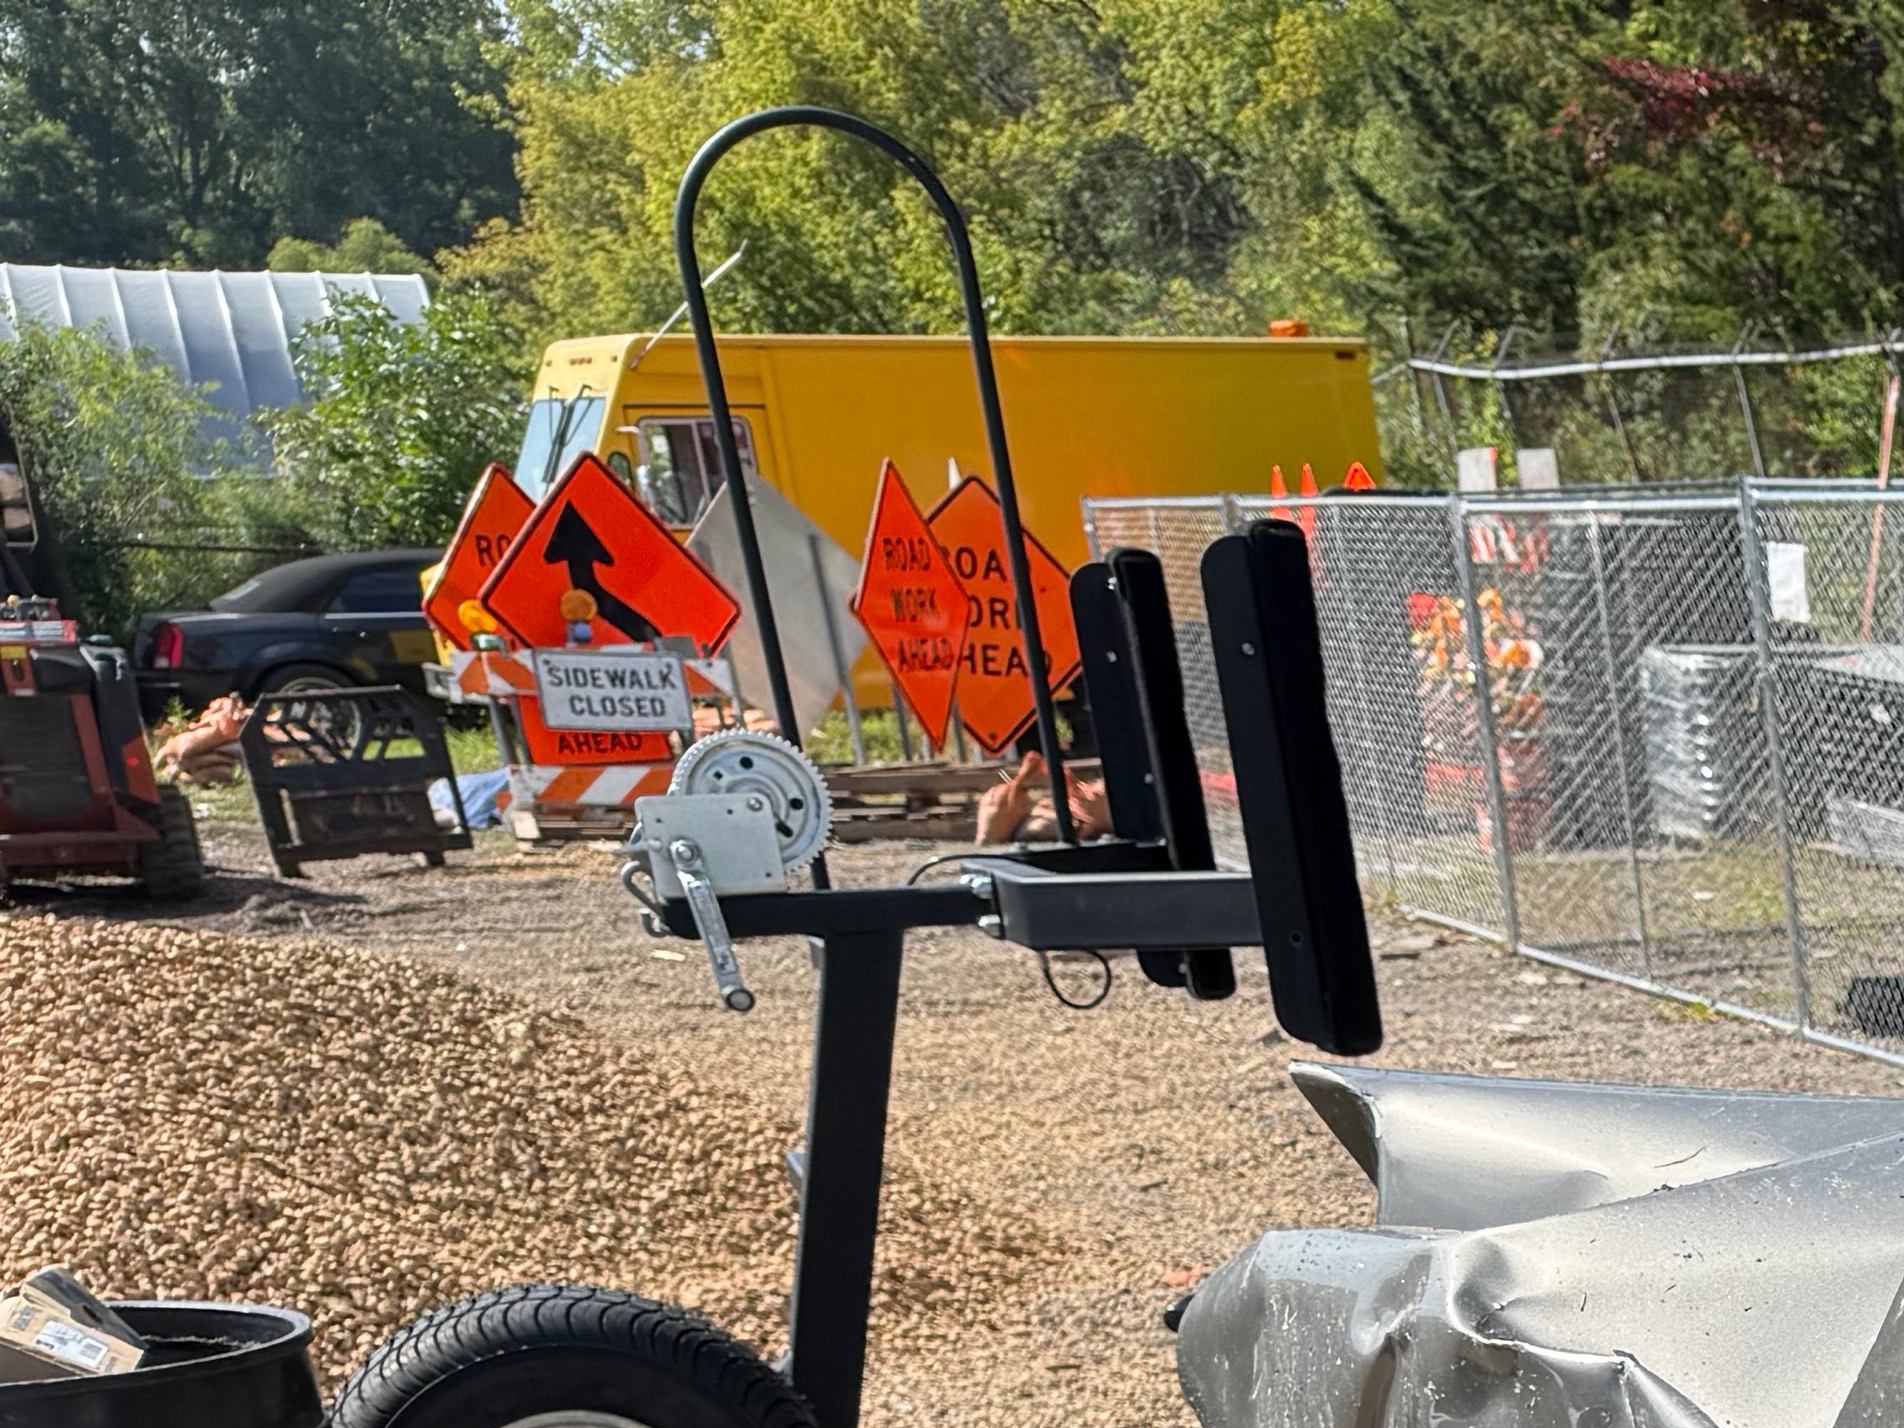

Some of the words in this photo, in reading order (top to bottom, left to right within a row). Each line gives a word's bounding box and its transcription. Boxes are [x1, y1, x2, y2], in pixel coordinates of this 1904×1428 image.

[475, 534, 512, 566] RO
[883, 537, 932, 571] ROAD
[897, 637, 953, 672] AHEAD
[548, 664, 677, 691] SIDEWALK
[569, 695, 667, 718] CLOSED
[558, 732, 644, 755] AHEAD
